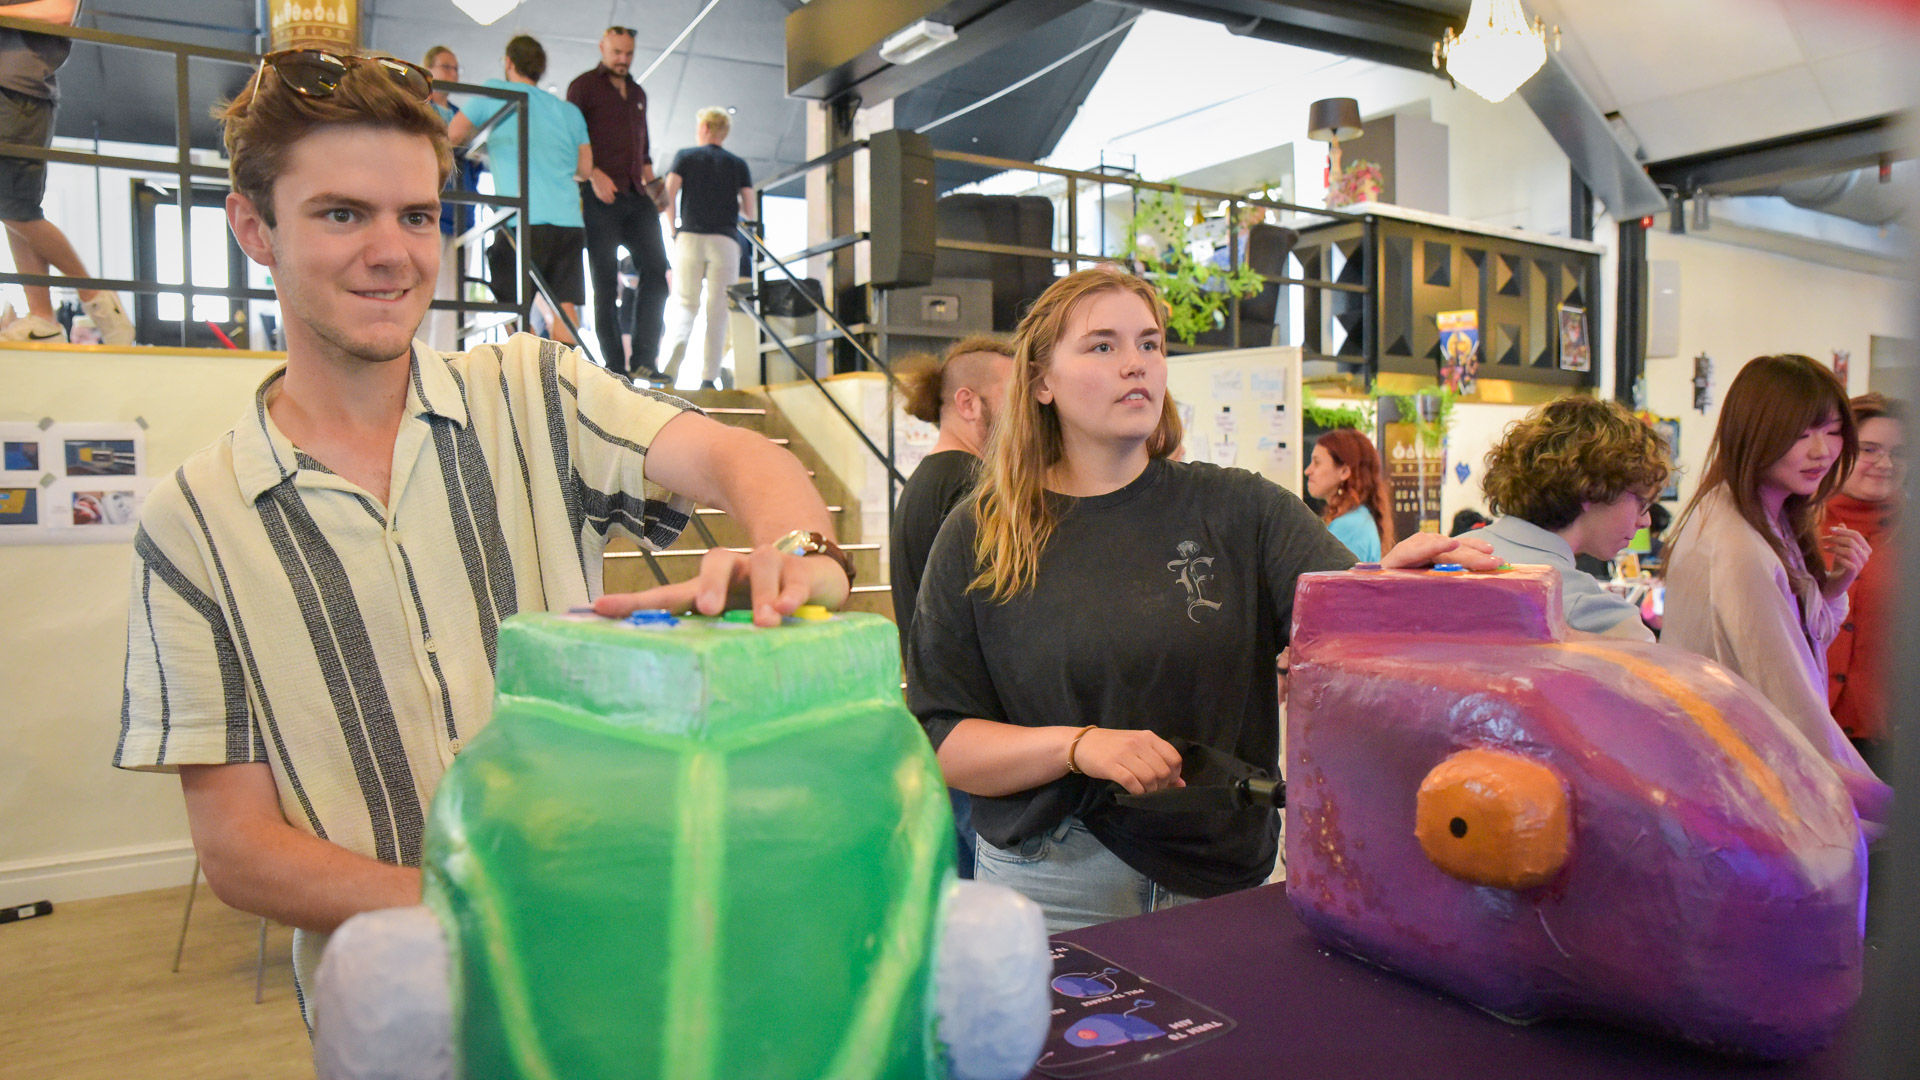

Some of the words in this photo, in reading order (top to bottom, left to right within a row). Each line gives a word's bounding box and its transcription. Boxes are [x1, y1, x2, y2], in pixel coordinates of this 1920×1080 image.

[1125, 988, 1145, 997] PULL
[1081, 995, 1112, 1007] CHARGE
[1168, 1018, 1193, 1030] AIM
[1186, 1021, 1223, 1036] TURN
[1168, 1032, 1188, 1041] TO
